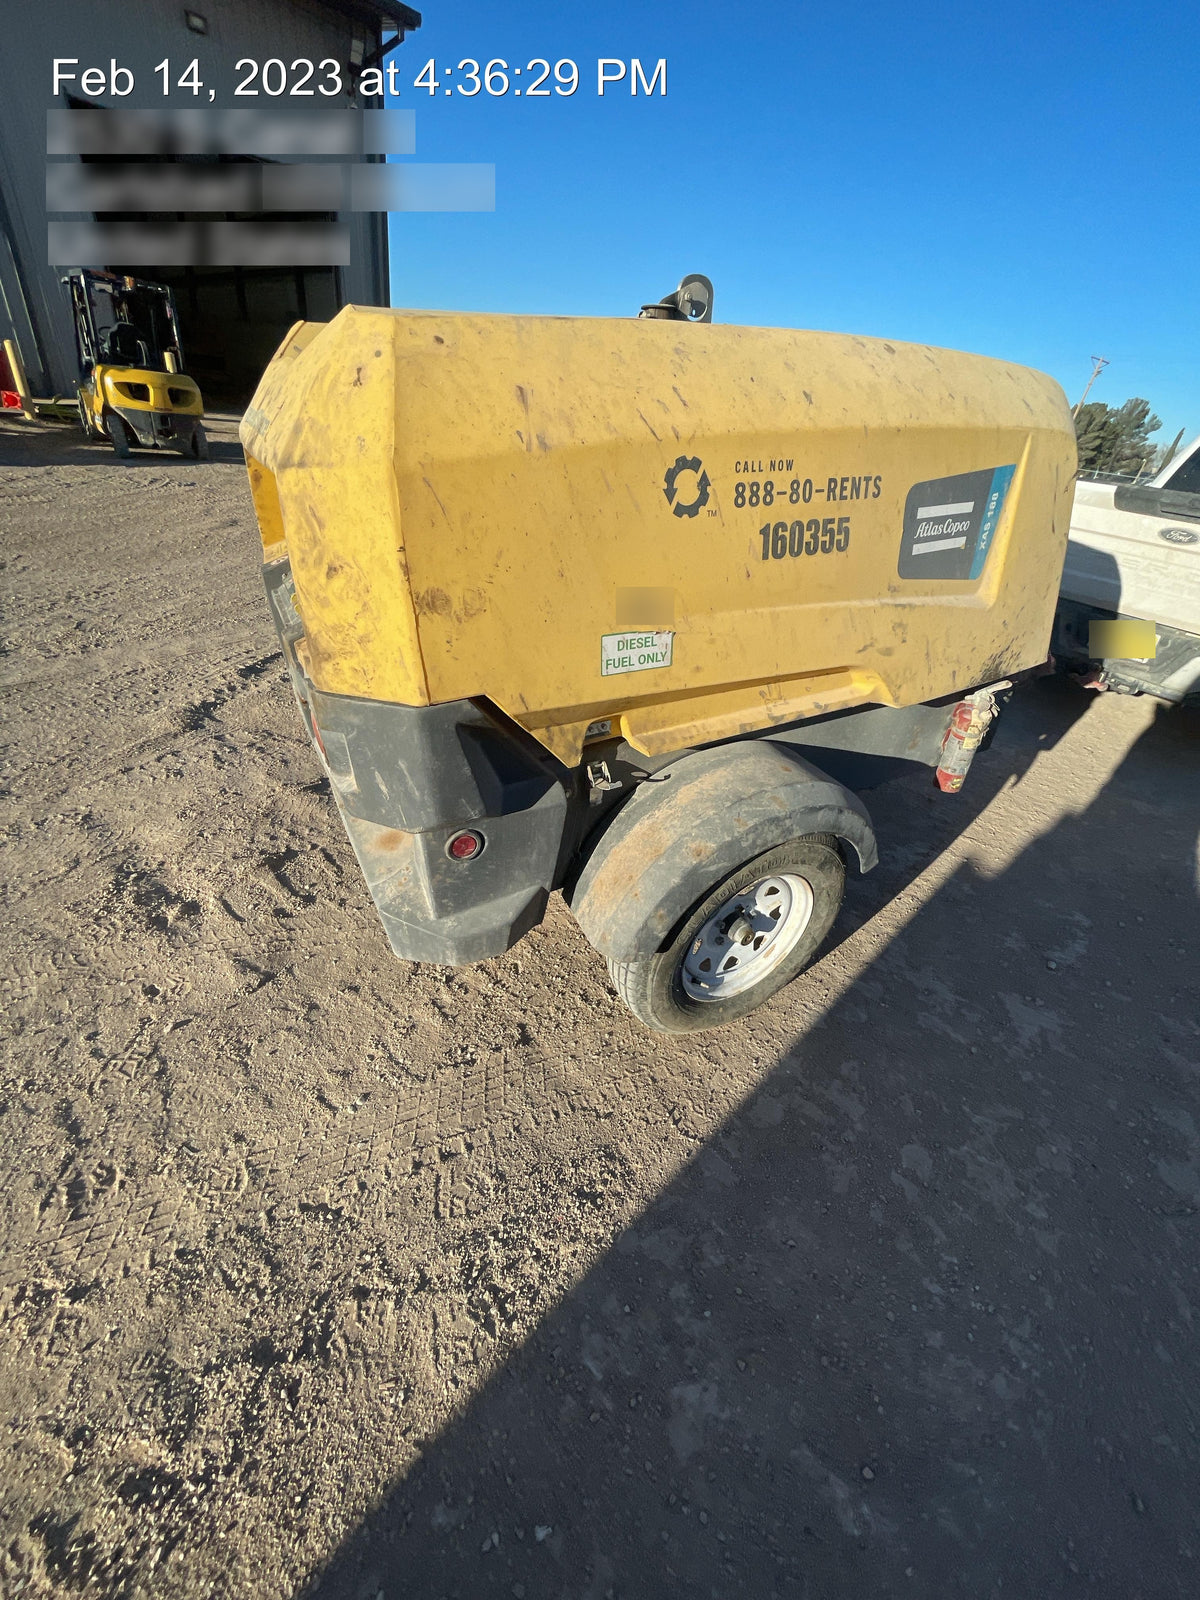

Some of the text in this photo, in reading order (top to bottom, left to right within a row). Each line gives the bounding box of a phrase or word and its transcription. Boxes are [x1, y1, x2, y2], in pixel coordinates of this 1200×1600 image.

[735, 459, 794, 473] CALL NOW
[734, 475, 882, 508] 888-80-RENTS
[759, 517, 851, 560] 160355
[1166, 530, 1193, 542] Ford
[617, 636, 657, 651] DIESEL
[605, 651, 668, 669] FUEL ONLY
